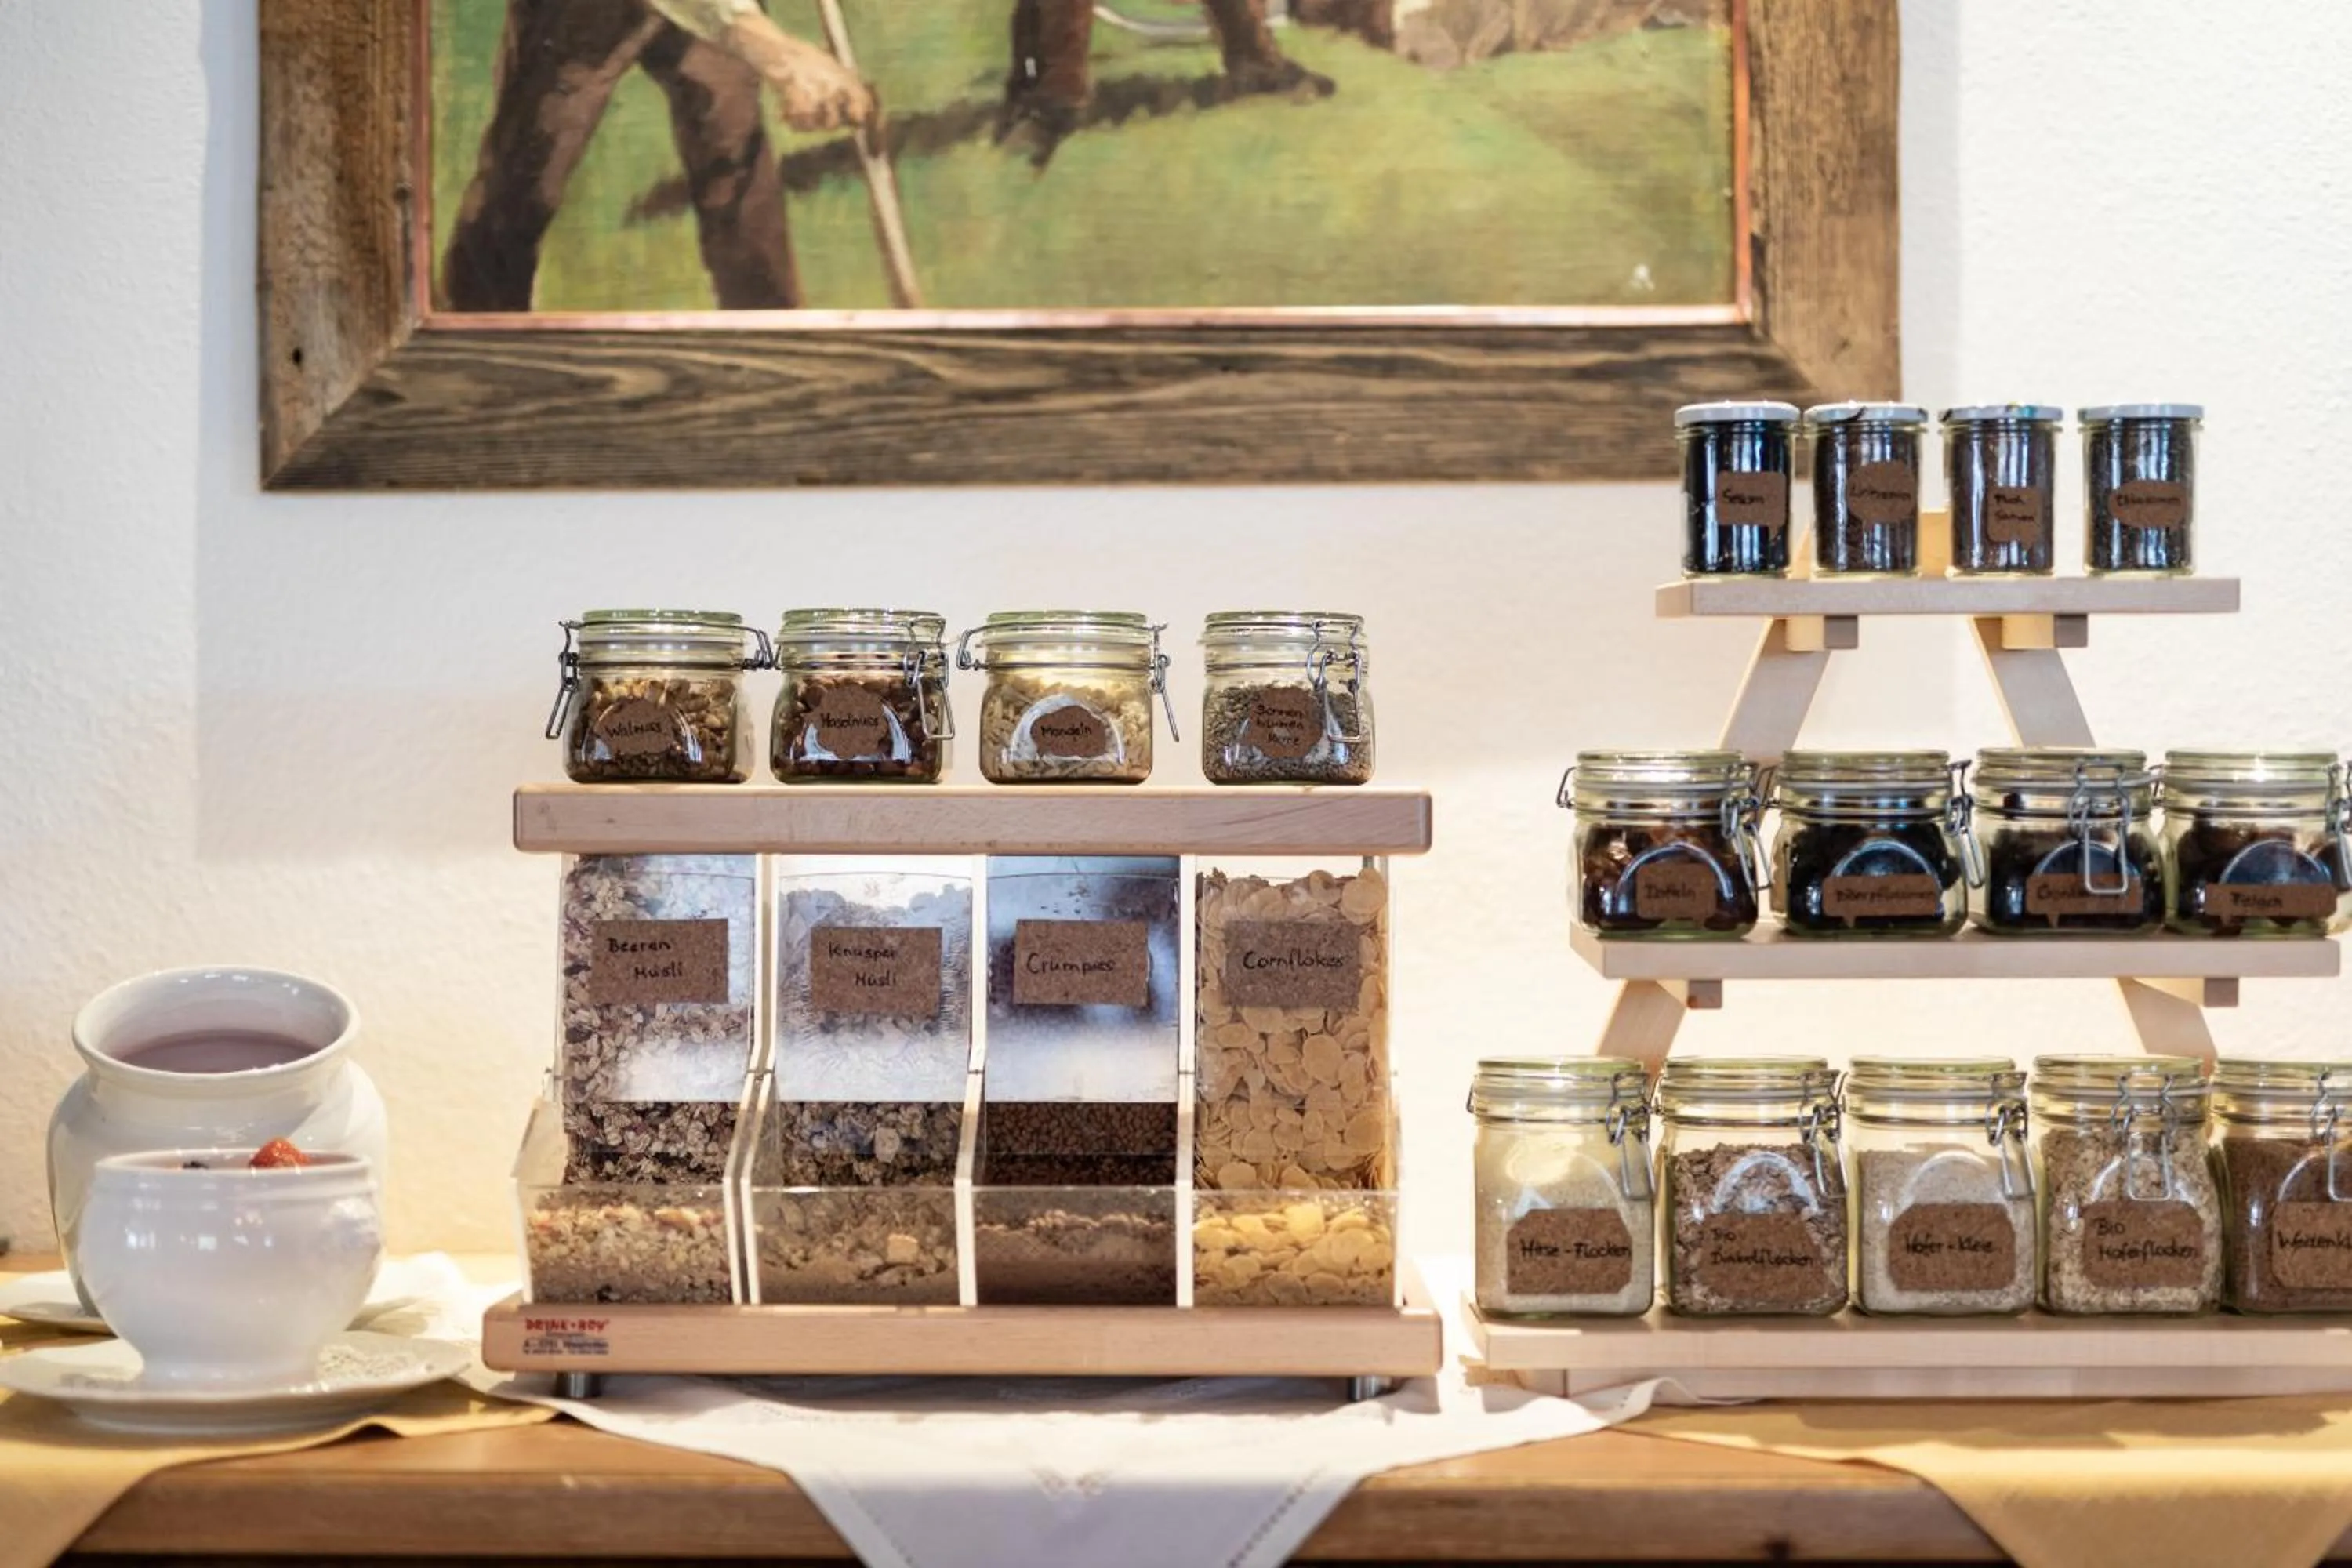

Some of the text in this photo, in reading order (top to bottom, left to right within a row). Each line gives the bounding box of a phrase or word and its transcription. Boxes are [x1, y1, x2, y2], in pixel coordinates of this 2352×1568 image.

[607, 937, 671, 953] Beeren
[828, 942, 897, 962] Knusper
[1243, 948, 1345, 973] Cornflakes
